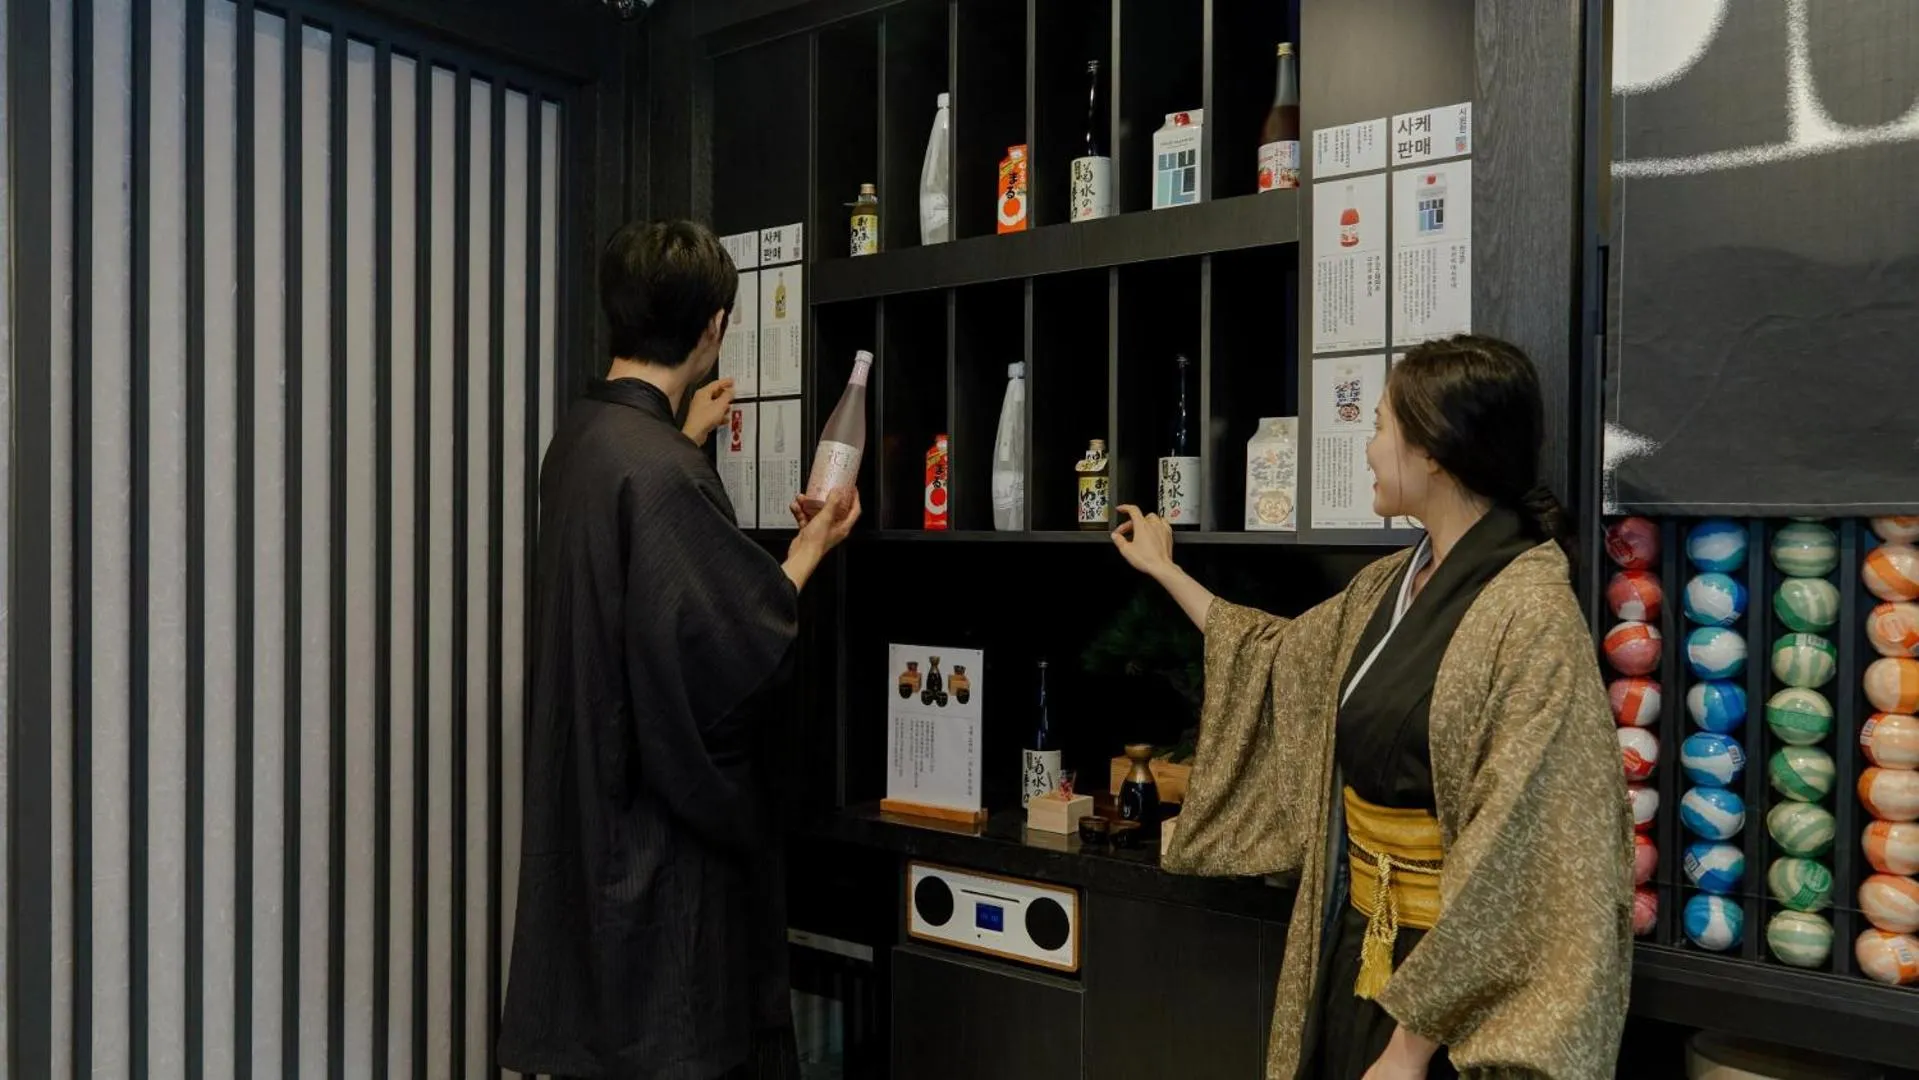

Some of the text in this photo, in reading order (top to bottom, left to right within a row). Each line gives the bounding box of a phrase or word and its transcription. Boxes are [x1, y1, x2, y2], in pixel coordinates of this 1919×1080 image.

[1397, 114, 1431, 136] 사케
[1397, 137, 1431, 159] 판매
[764, 230, 782, 243] 사케
[764, 247, 782, 262] 판매
